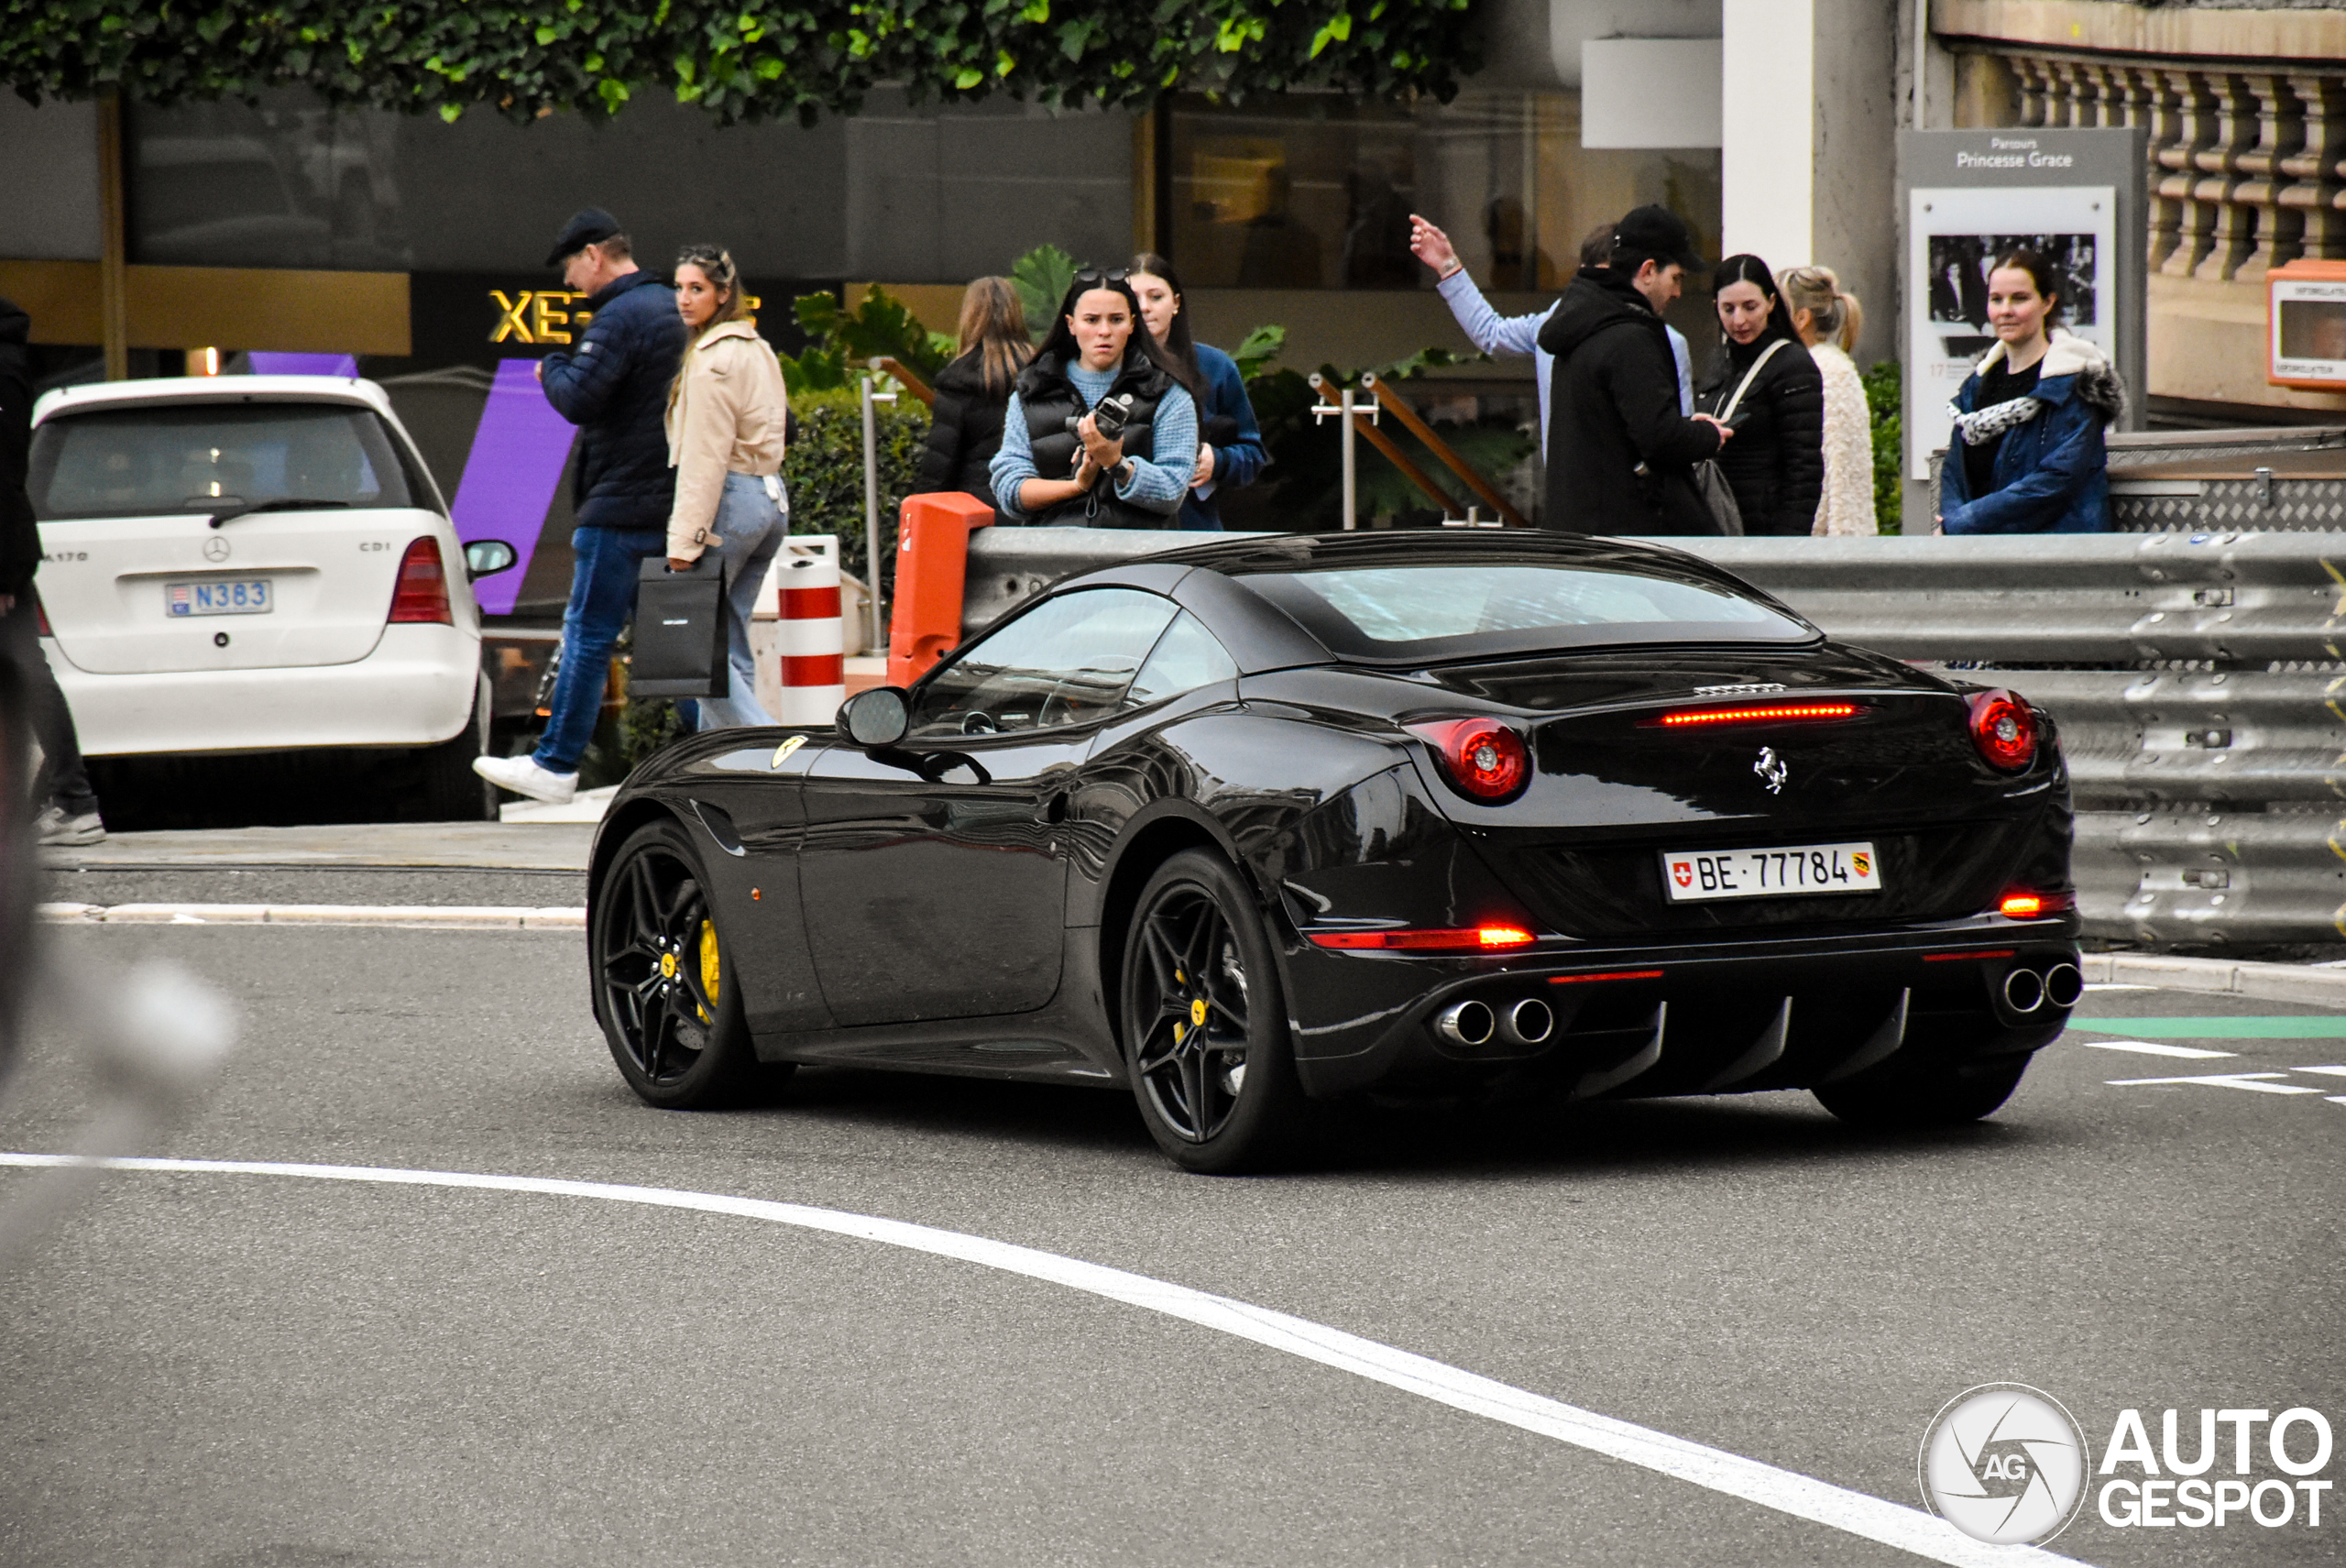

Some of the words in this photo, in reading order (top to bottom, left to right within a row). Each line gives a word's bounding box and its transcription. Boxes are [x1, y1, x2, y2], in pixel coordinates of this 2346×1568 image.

[1957, 151, 2025, 167] Princesse
[2028, 150, 2074, 167] Grace
[359, 542, 390, 552] CDI
[196, 582, 266, 607] N383
